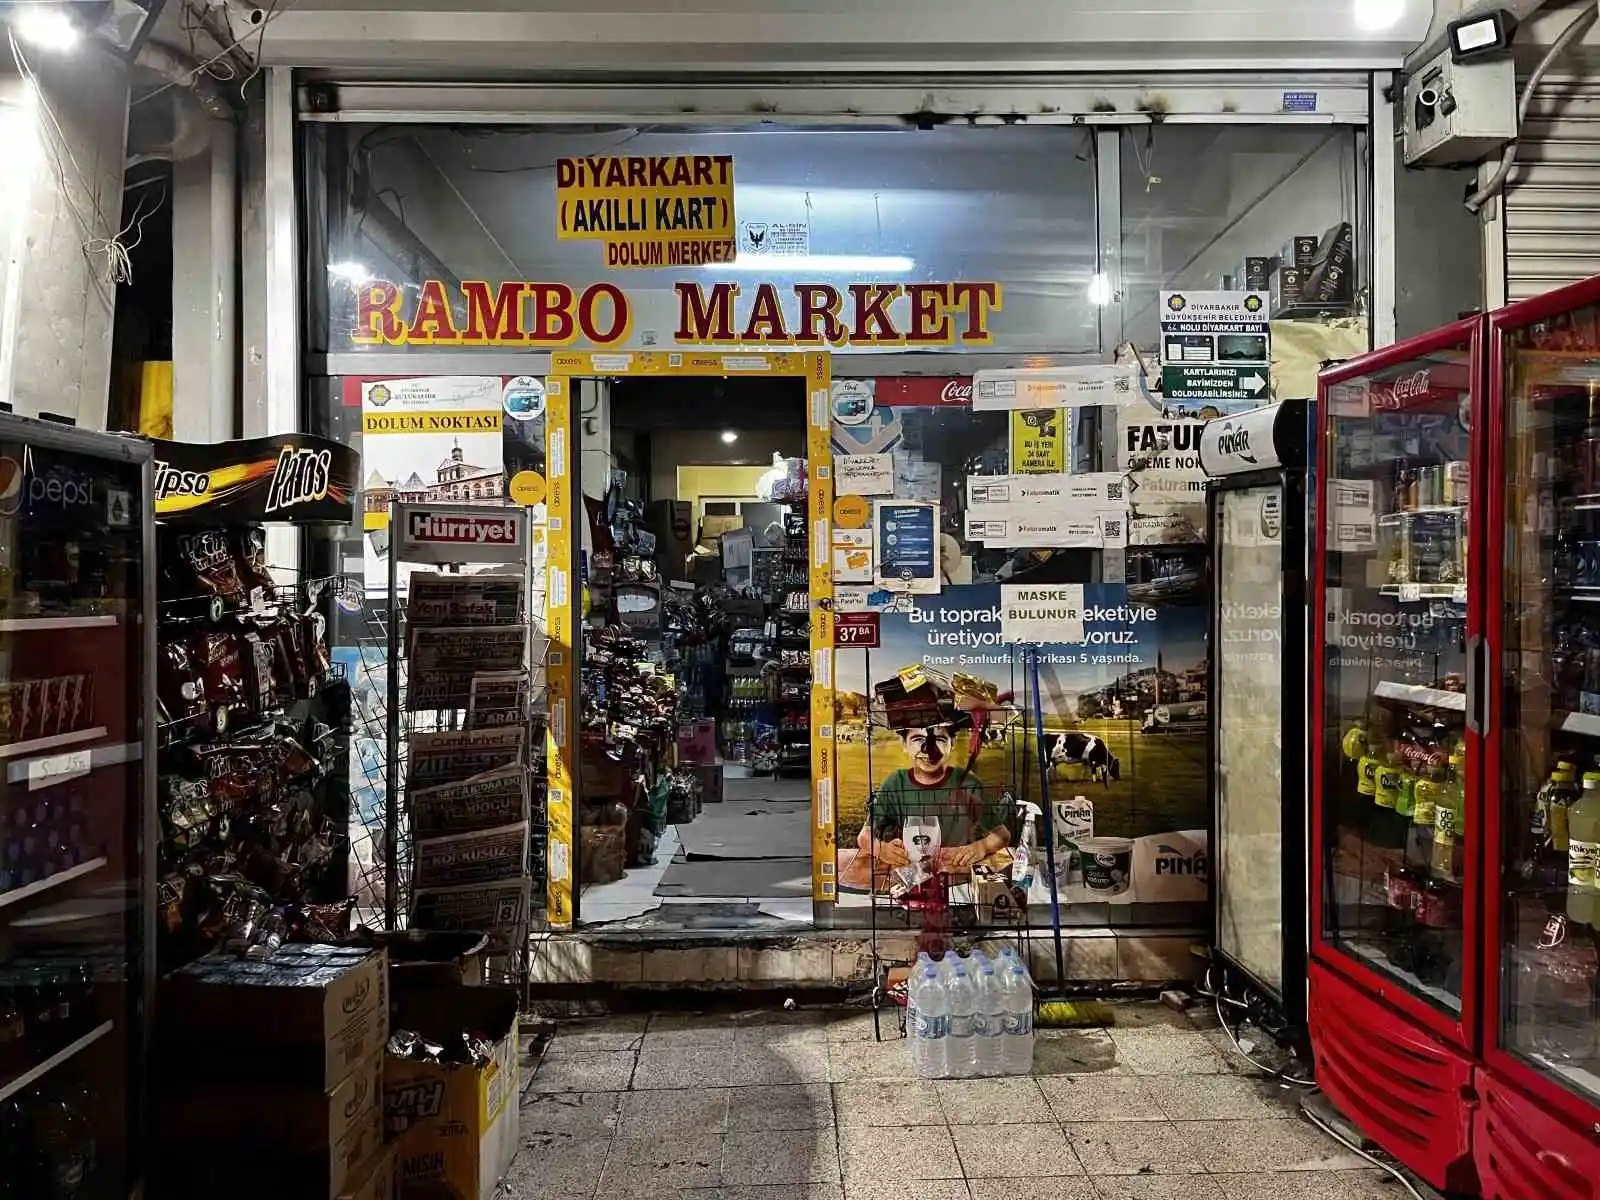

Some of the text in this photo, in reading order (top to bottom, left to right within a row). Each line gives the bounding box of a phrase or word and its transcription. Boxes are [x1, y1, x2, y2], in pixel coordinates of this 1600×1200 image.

[608, 240, 665, 266] DOLUM
[352, 279, 1003, 347] RAMBO MARKET
[1179, 322, 1201, 332] NOLU
[1392, 369, 1432, 409] Coca-Cola
[366, 414, 499, 431] DOLUM NOKTASI
[28, 475, 95, 510] pepsi
[413, 514, 515, 543] Hürriyet
[1017, 590, 1068, 601] MASKE
[908, 603, 1158, 627] Bu toprak eketiyle
[1008, 608, 1077, 620] BULUNUR
[839, 627, 857, 642] 37
[922, 654, 956, 666] Pınar
[1079, 654, 1088, 666] 5
[1091, 653, 1143, 668] yaşında.
